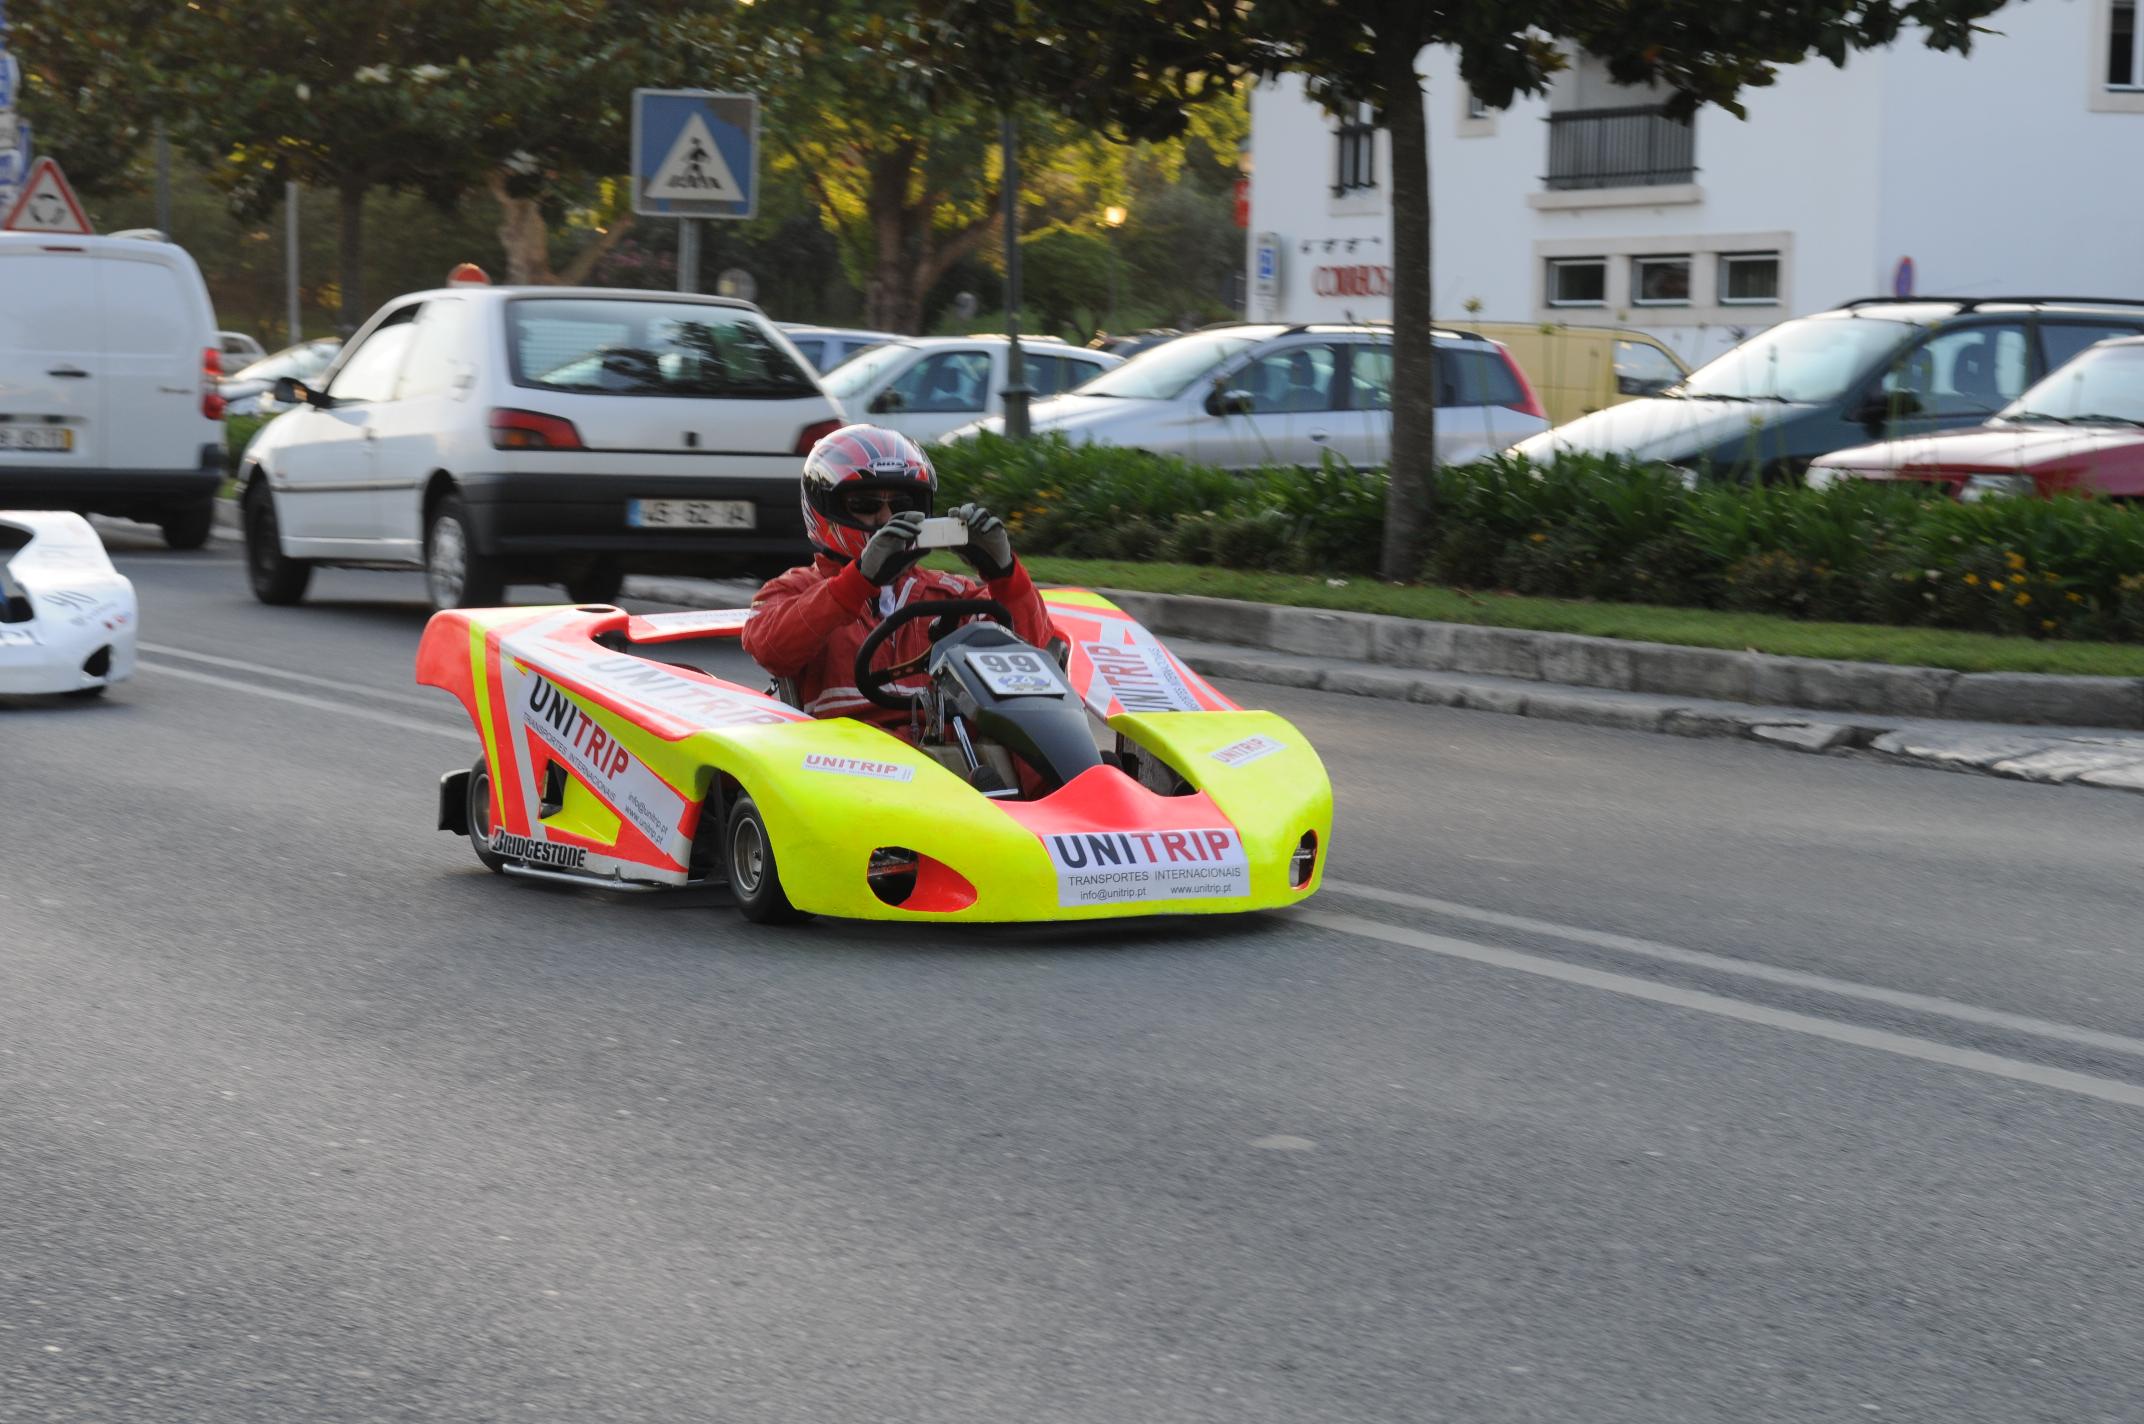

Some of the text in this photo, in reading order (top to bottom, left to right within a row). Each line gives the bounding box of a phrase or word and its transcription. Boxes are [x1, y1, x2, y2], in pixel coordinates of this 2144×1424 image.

[980, 654, 1041, 673] 99
[588, 657, 786, 728] UNITRIP
[529, 675, 629, 781] UNITRIP
[524, 711, 617, 802] TRANSPORTES INTERNACIONAIS
[806, 754, 899, 774] UNITRIP
[492, 828, 587, 868] BRIDGESTONE
[1053, 830, 1231, 868] UNITRIP
[1068, 867, 1242, 887] TRANSPORTES INTERNACIONAIS
[1080, 883, 1232, 901] info@unitrip.pt www.unitrip.pt
